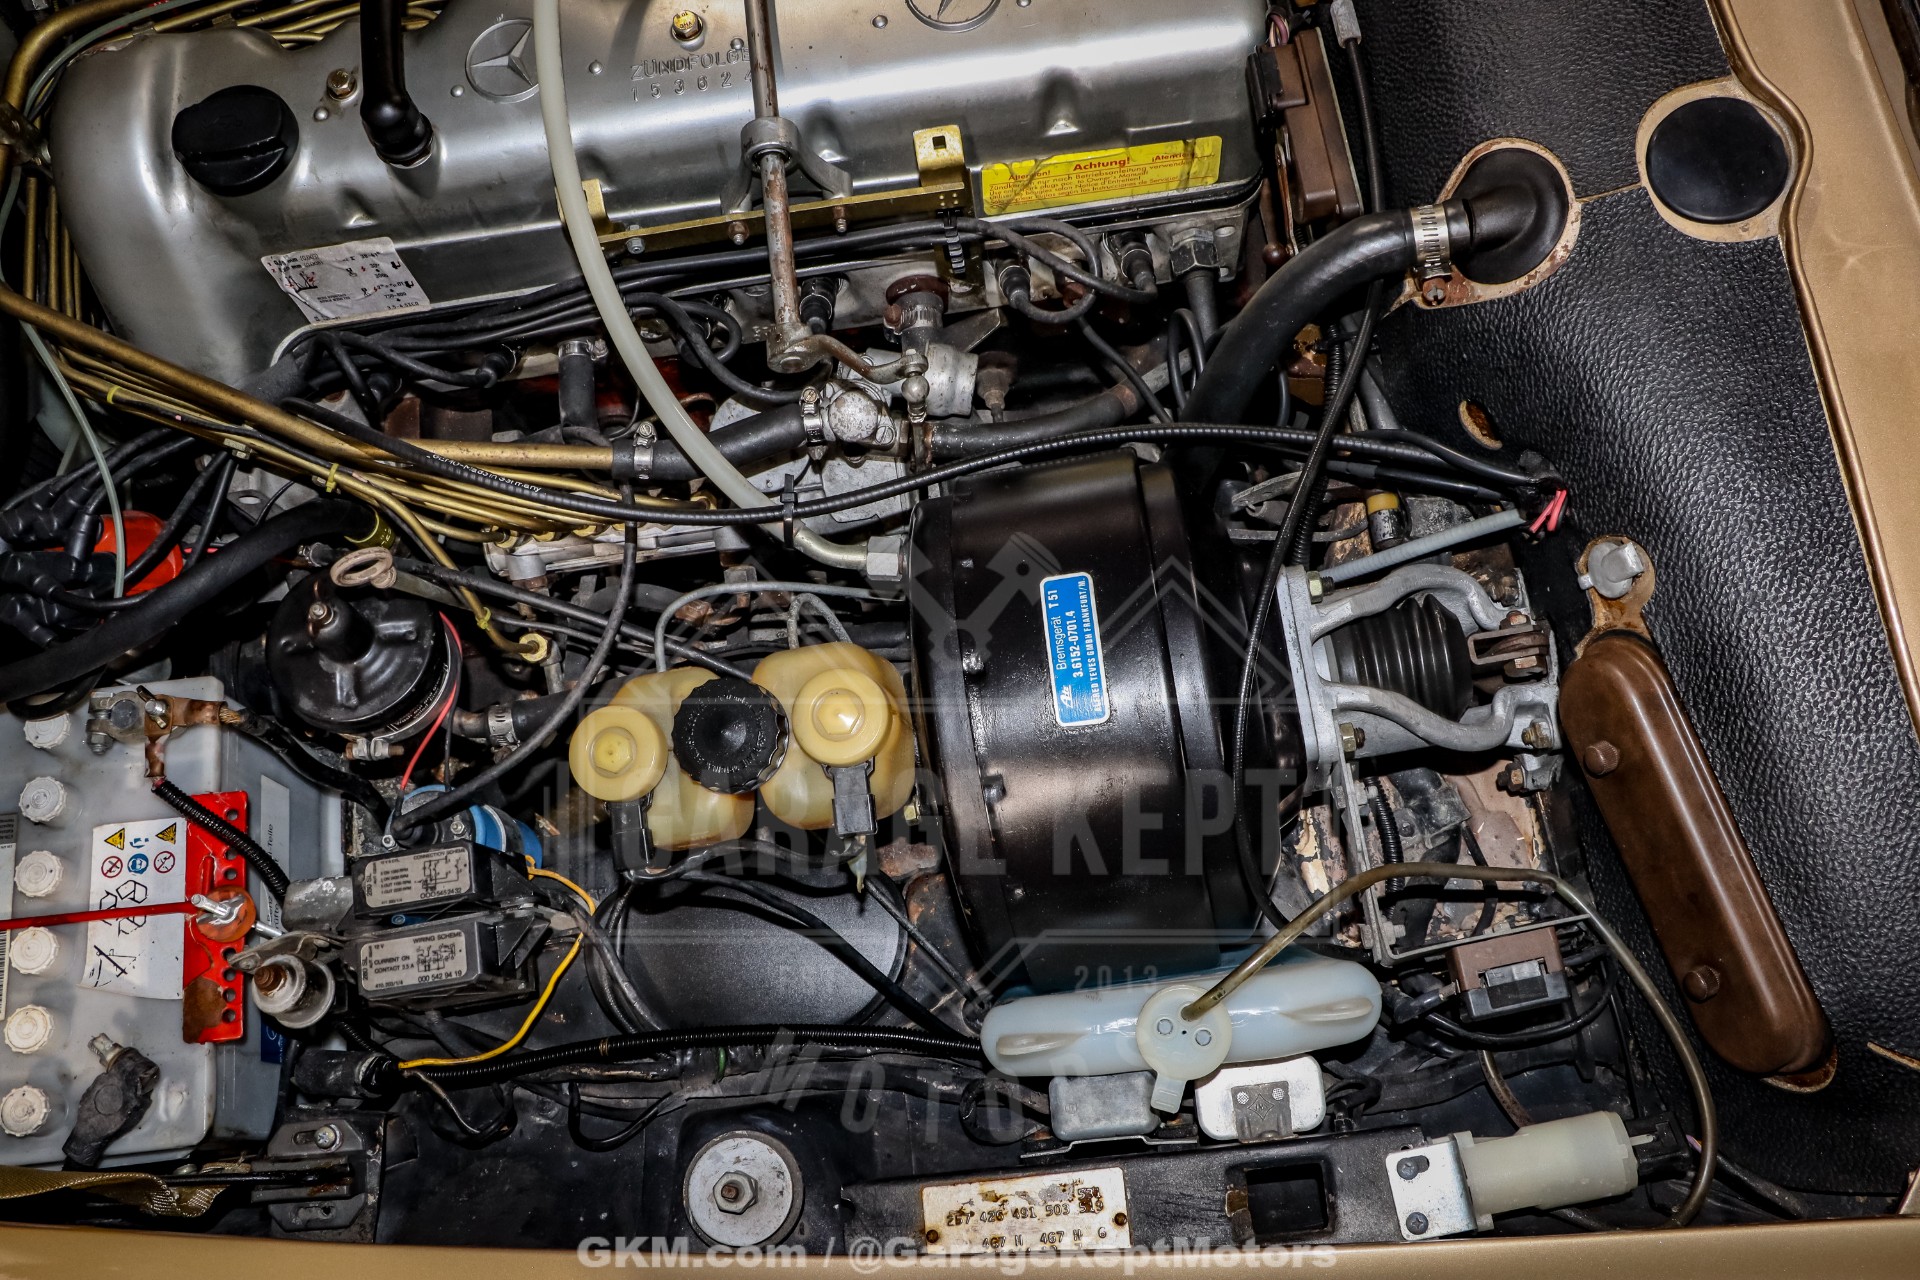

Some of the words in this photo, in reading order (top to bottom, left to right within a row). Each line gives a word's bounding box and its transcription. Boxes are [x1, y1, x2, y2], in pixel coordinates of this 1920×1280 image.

[1073, 156, 1130, 172] Achtung!
[1053, 173, 1073, 183] nach
[1075, 166, 1147, 179] Betriebsanleitung
[1075, 181, 1099, 189] Notice
[1051, 615, 1067, 671] Bremsgerät
[1065, 610, 1084, 678] 3.6152-0701.4
[1085, 631, 1095, 656] GMBH
[1088, 657, 1099, 681] TEVES
[1090, 682, 1103, 712] ALFRED
[413, 851, 445, 861] CONNECTION
[446, 848, 466, 856] SCHEME
[413, 934, 436, 944] WIRING
[437, 931, 462, 941] SCHEME
[373, 957, 400, 966] CURRENT
[374, 965, 401, 974] CONTACT
[1012, 1206, 1037, 1219] 491
[1045, 1203, 1070, 1216] 503
[1039, 1231, 1065, 1244] 467
